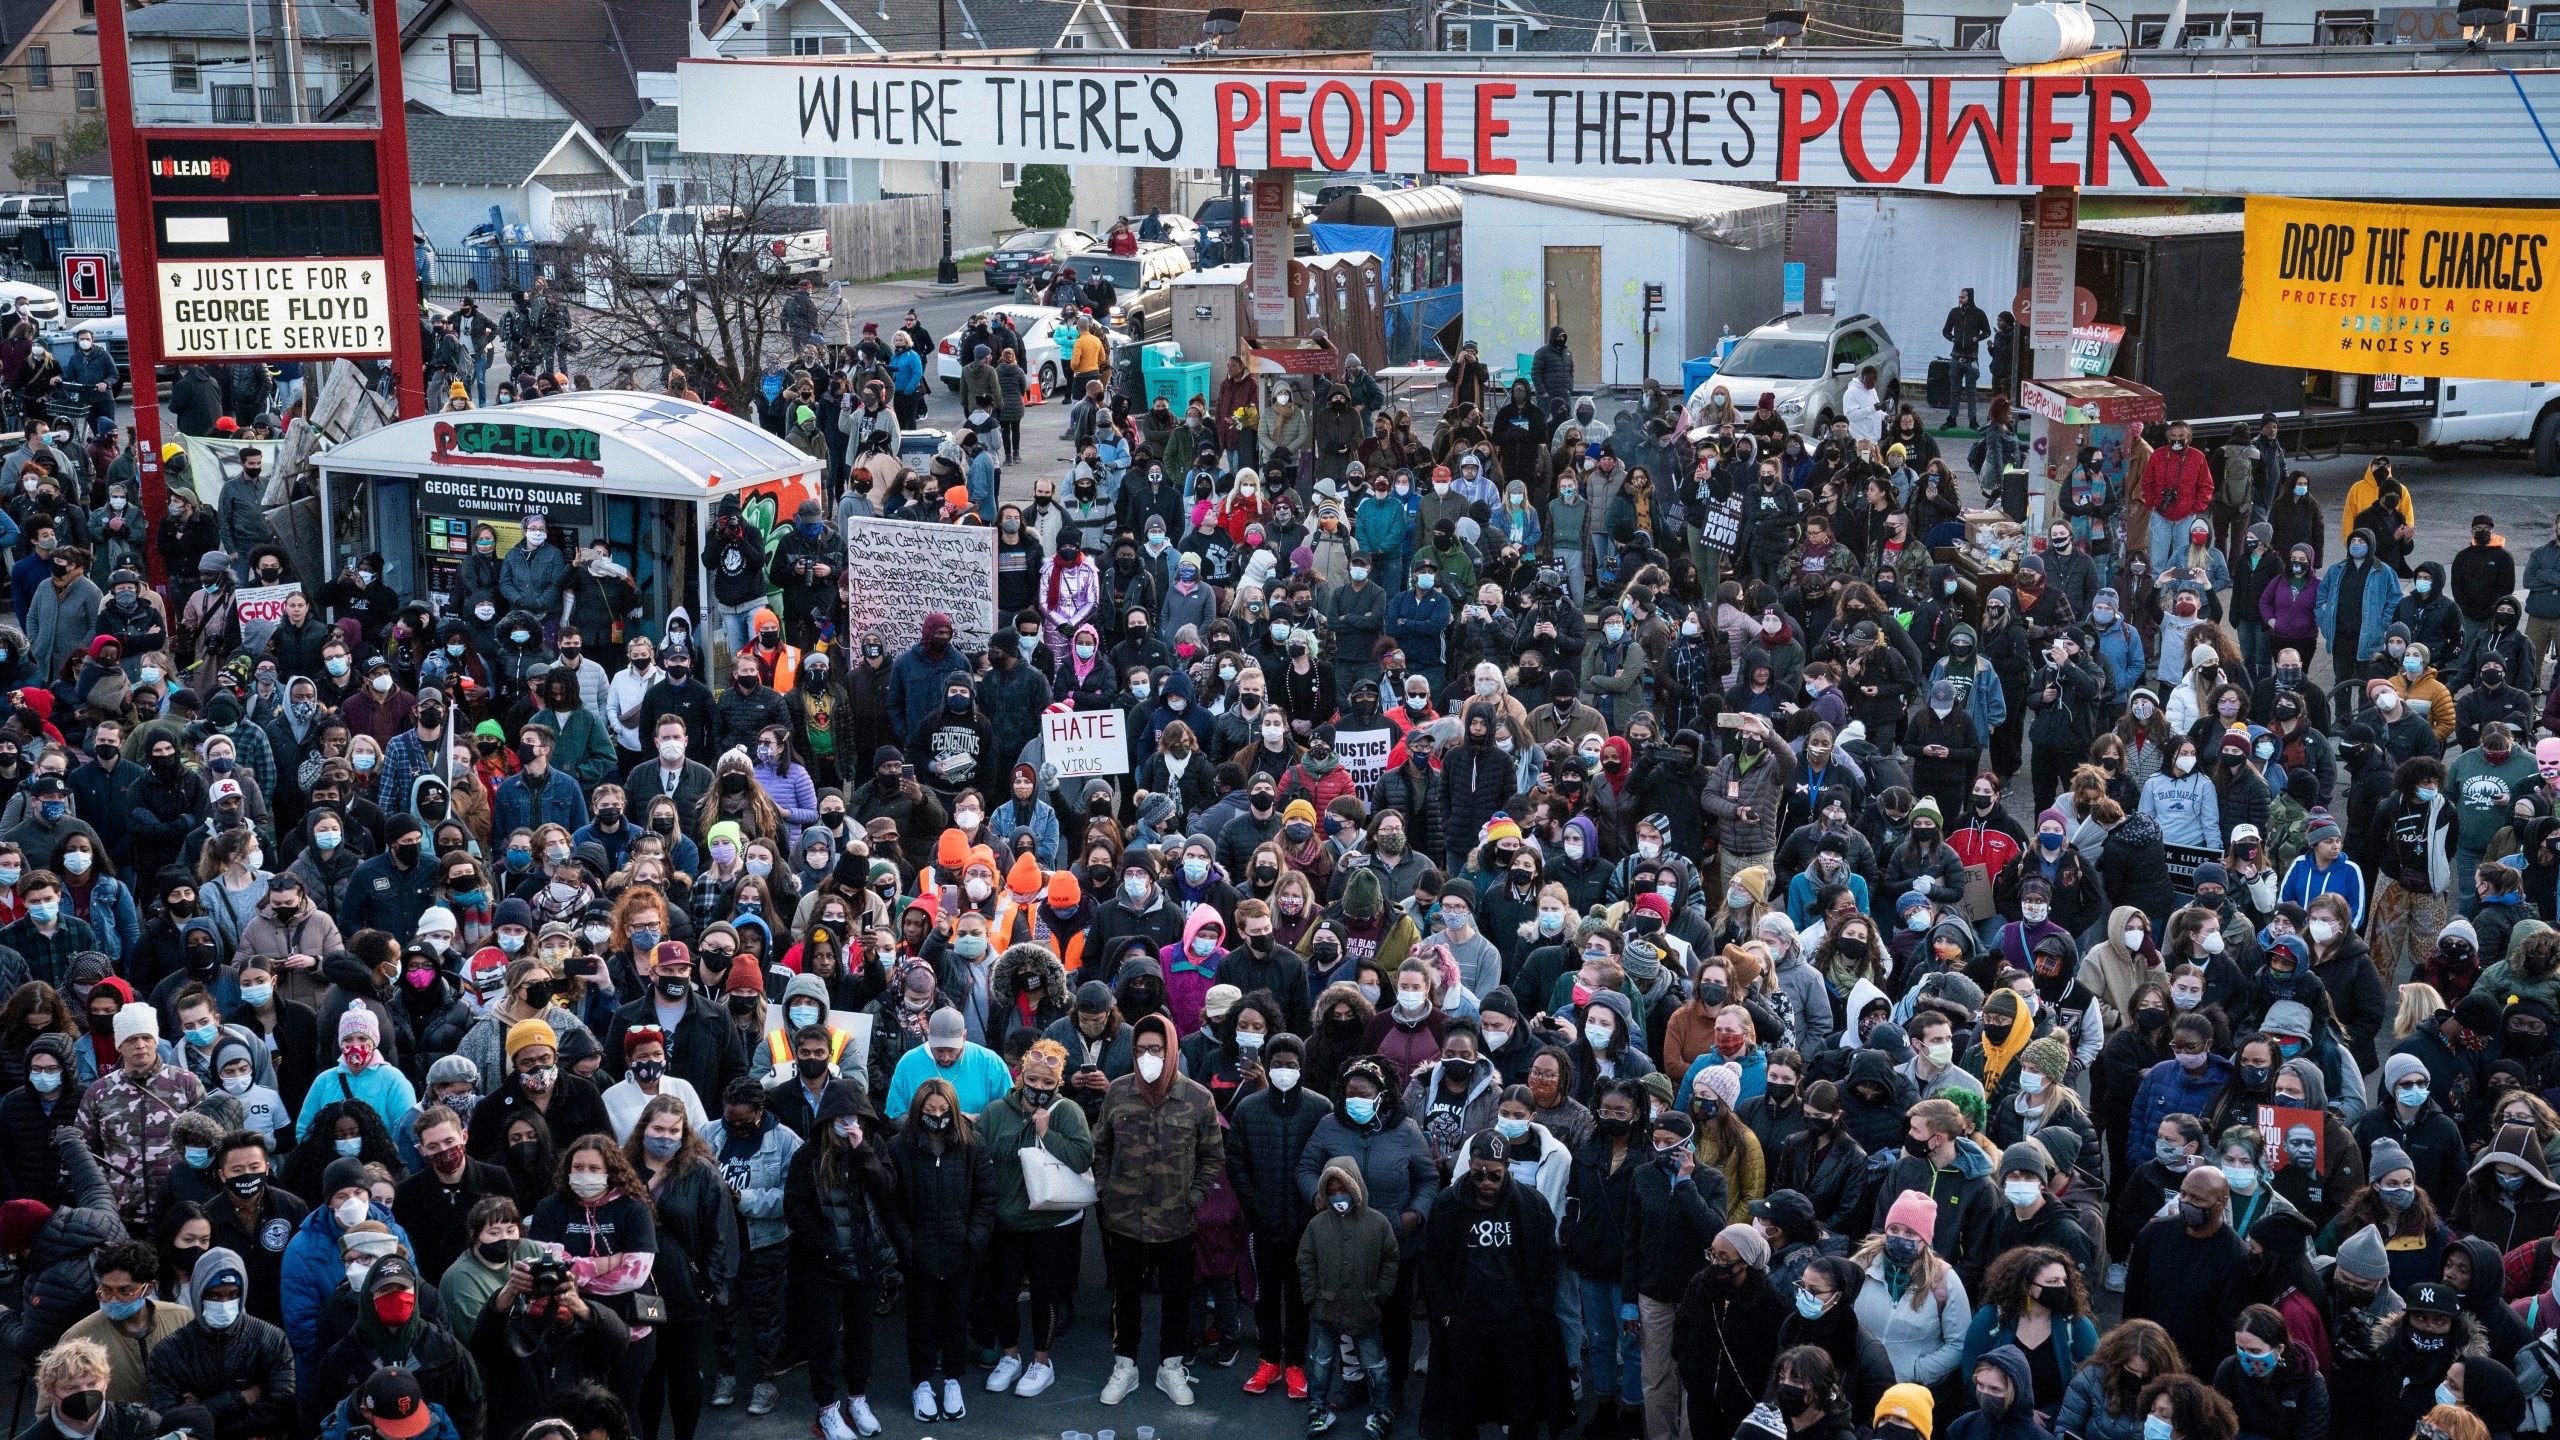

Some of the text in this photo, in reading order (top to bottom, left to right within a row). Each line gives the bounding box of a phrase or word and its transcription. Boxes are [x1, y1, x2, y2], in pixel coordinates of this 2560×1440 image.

[798, 74, 2170, 187] WHERE THERE'S PEOPLE THERE'S POWER
[152, 160, 230, 176] UNLEADED
[2038, 230, 2061, 238] SELF
[2279, 222, 2548, 292] DROP THE CHARGES
[193, 267, 348, 291] JUSTICE FOR
[1293, 274, 1302, 285] 3
[175, 297, 369, 323] GEORGE FLOYD
[2021, 301, 2031, 314] 2
[2079, 301, 2087, 315] 1
[2281, 289, 2531, 315] PROTEST IS NOT A CRIME
[177, 328, 273, 351] JUSTICE
[2071, 338, 2102, 357] LIVES
[2069, 357, 2102, 372] ATTER
[2384, 381, 2396, 390] ONE
[425, 480, 583, 506] GEORGE FLOYD SQUARE
[458, 499, 549, 515] COMMUNITY INFO
[1711, 496, 1743, 513] TICE
[1707, 510, 1740, 532] GEORGE
[1703, 522, 1737, 546] FLOYD
[942, 726, 974, 734] PITTSBURGH
[1051, 714, 1116, 742] HATE
[931, 732, 981, 755] PENGUINS
[1062, 757, 1102, 772] VIRUS
[1353, 758, 1367, 767] FOR
[2462, 775, 2484, 794] CHESTNUT
[2484, 774, 2500, 783] LAKE
[2158, 789, 2199, 801] GRAND MARAIS
[2181, 853, 2210, 864] LIVES
[2166, 864, 2194, 875] TTER
[1358, 938, 1377, 949] BLAC
[2258, 1106, 2274, 1126] DO
[2259, 1125, 2281, 1146] YOU
[2266, 1145, 2280, 1163] EE
